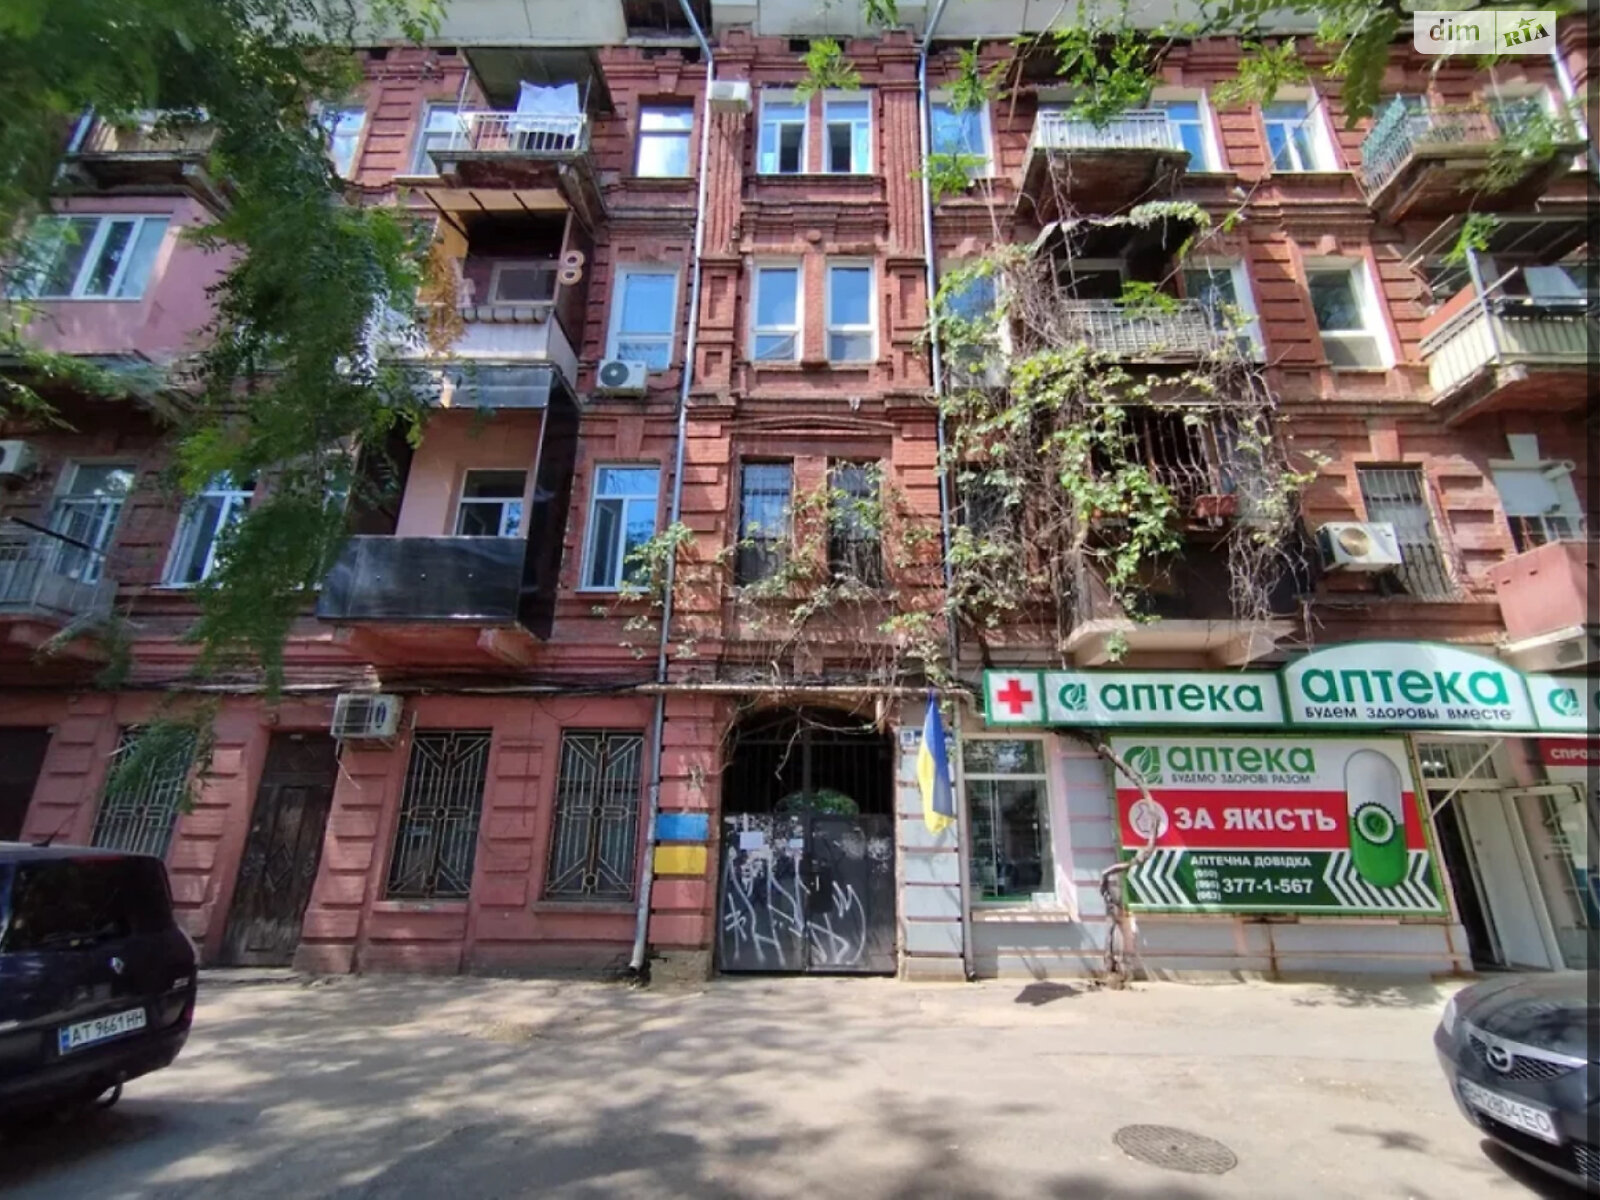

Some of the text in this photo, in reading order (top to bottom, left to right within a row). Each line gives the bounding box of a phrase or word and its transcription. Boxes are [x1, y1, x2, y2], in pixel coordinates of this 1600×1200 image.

[1100, 683, 1264, 712] аптека
[1301, 668, 1510, 705] аптека
[1166, 746, 1316, 773] аптека
[1272, 774, 1311, 784] РАЗОМ
[1174, 807, 1338, 832] ЗА ЯКІСТЬ
[1190, 855, 1312, 868] АПТЕЧНА ДОВІДКА
[1222, 878, 1313, 894] 377-1-567
[72, 1023, 92, 1043] AT
